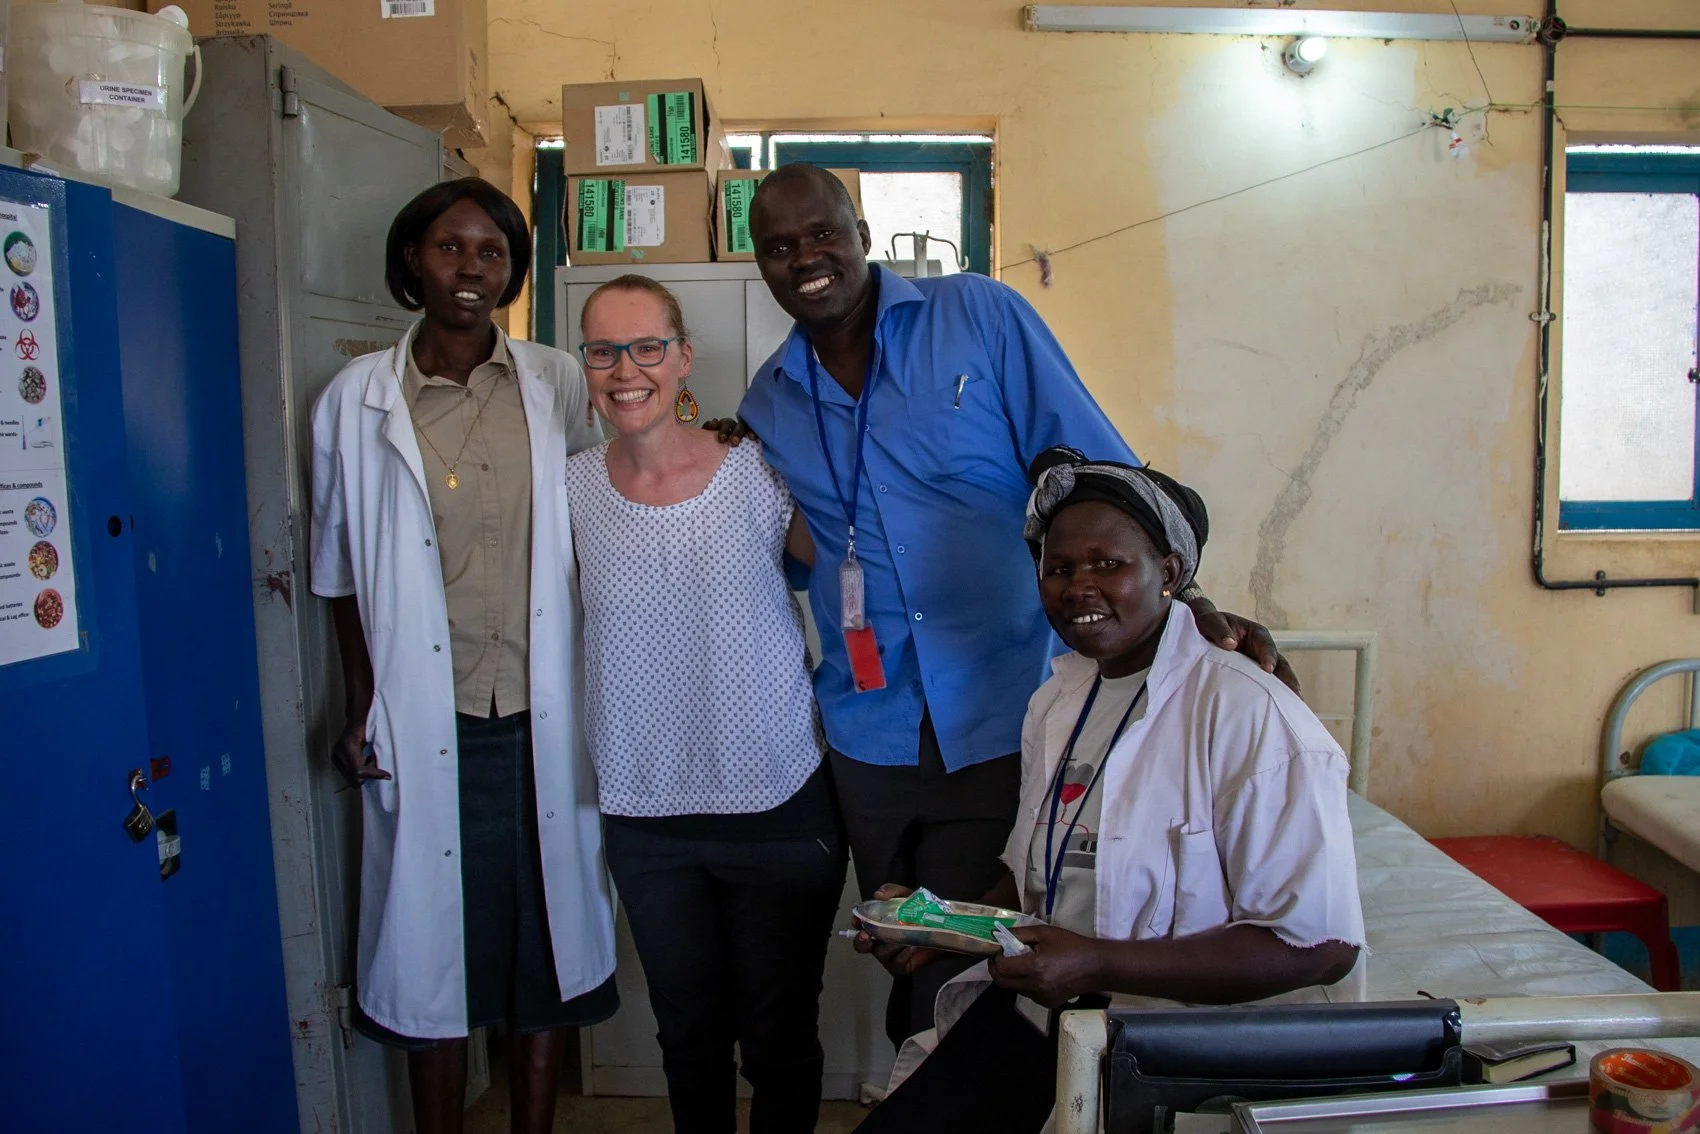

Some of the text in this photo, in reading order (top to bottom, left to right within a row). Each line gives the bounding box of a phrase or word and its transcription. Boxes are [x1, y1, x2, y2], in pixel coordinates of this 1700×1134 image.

[100, 85, 152, 97] URINE SPECIMEN
[109, 94, 145, 103] CONTAINER
[679, 126, 690, 160] 141580
[584, 183, 595, 217] 141580
[731, 183, 743, 218] 141580
